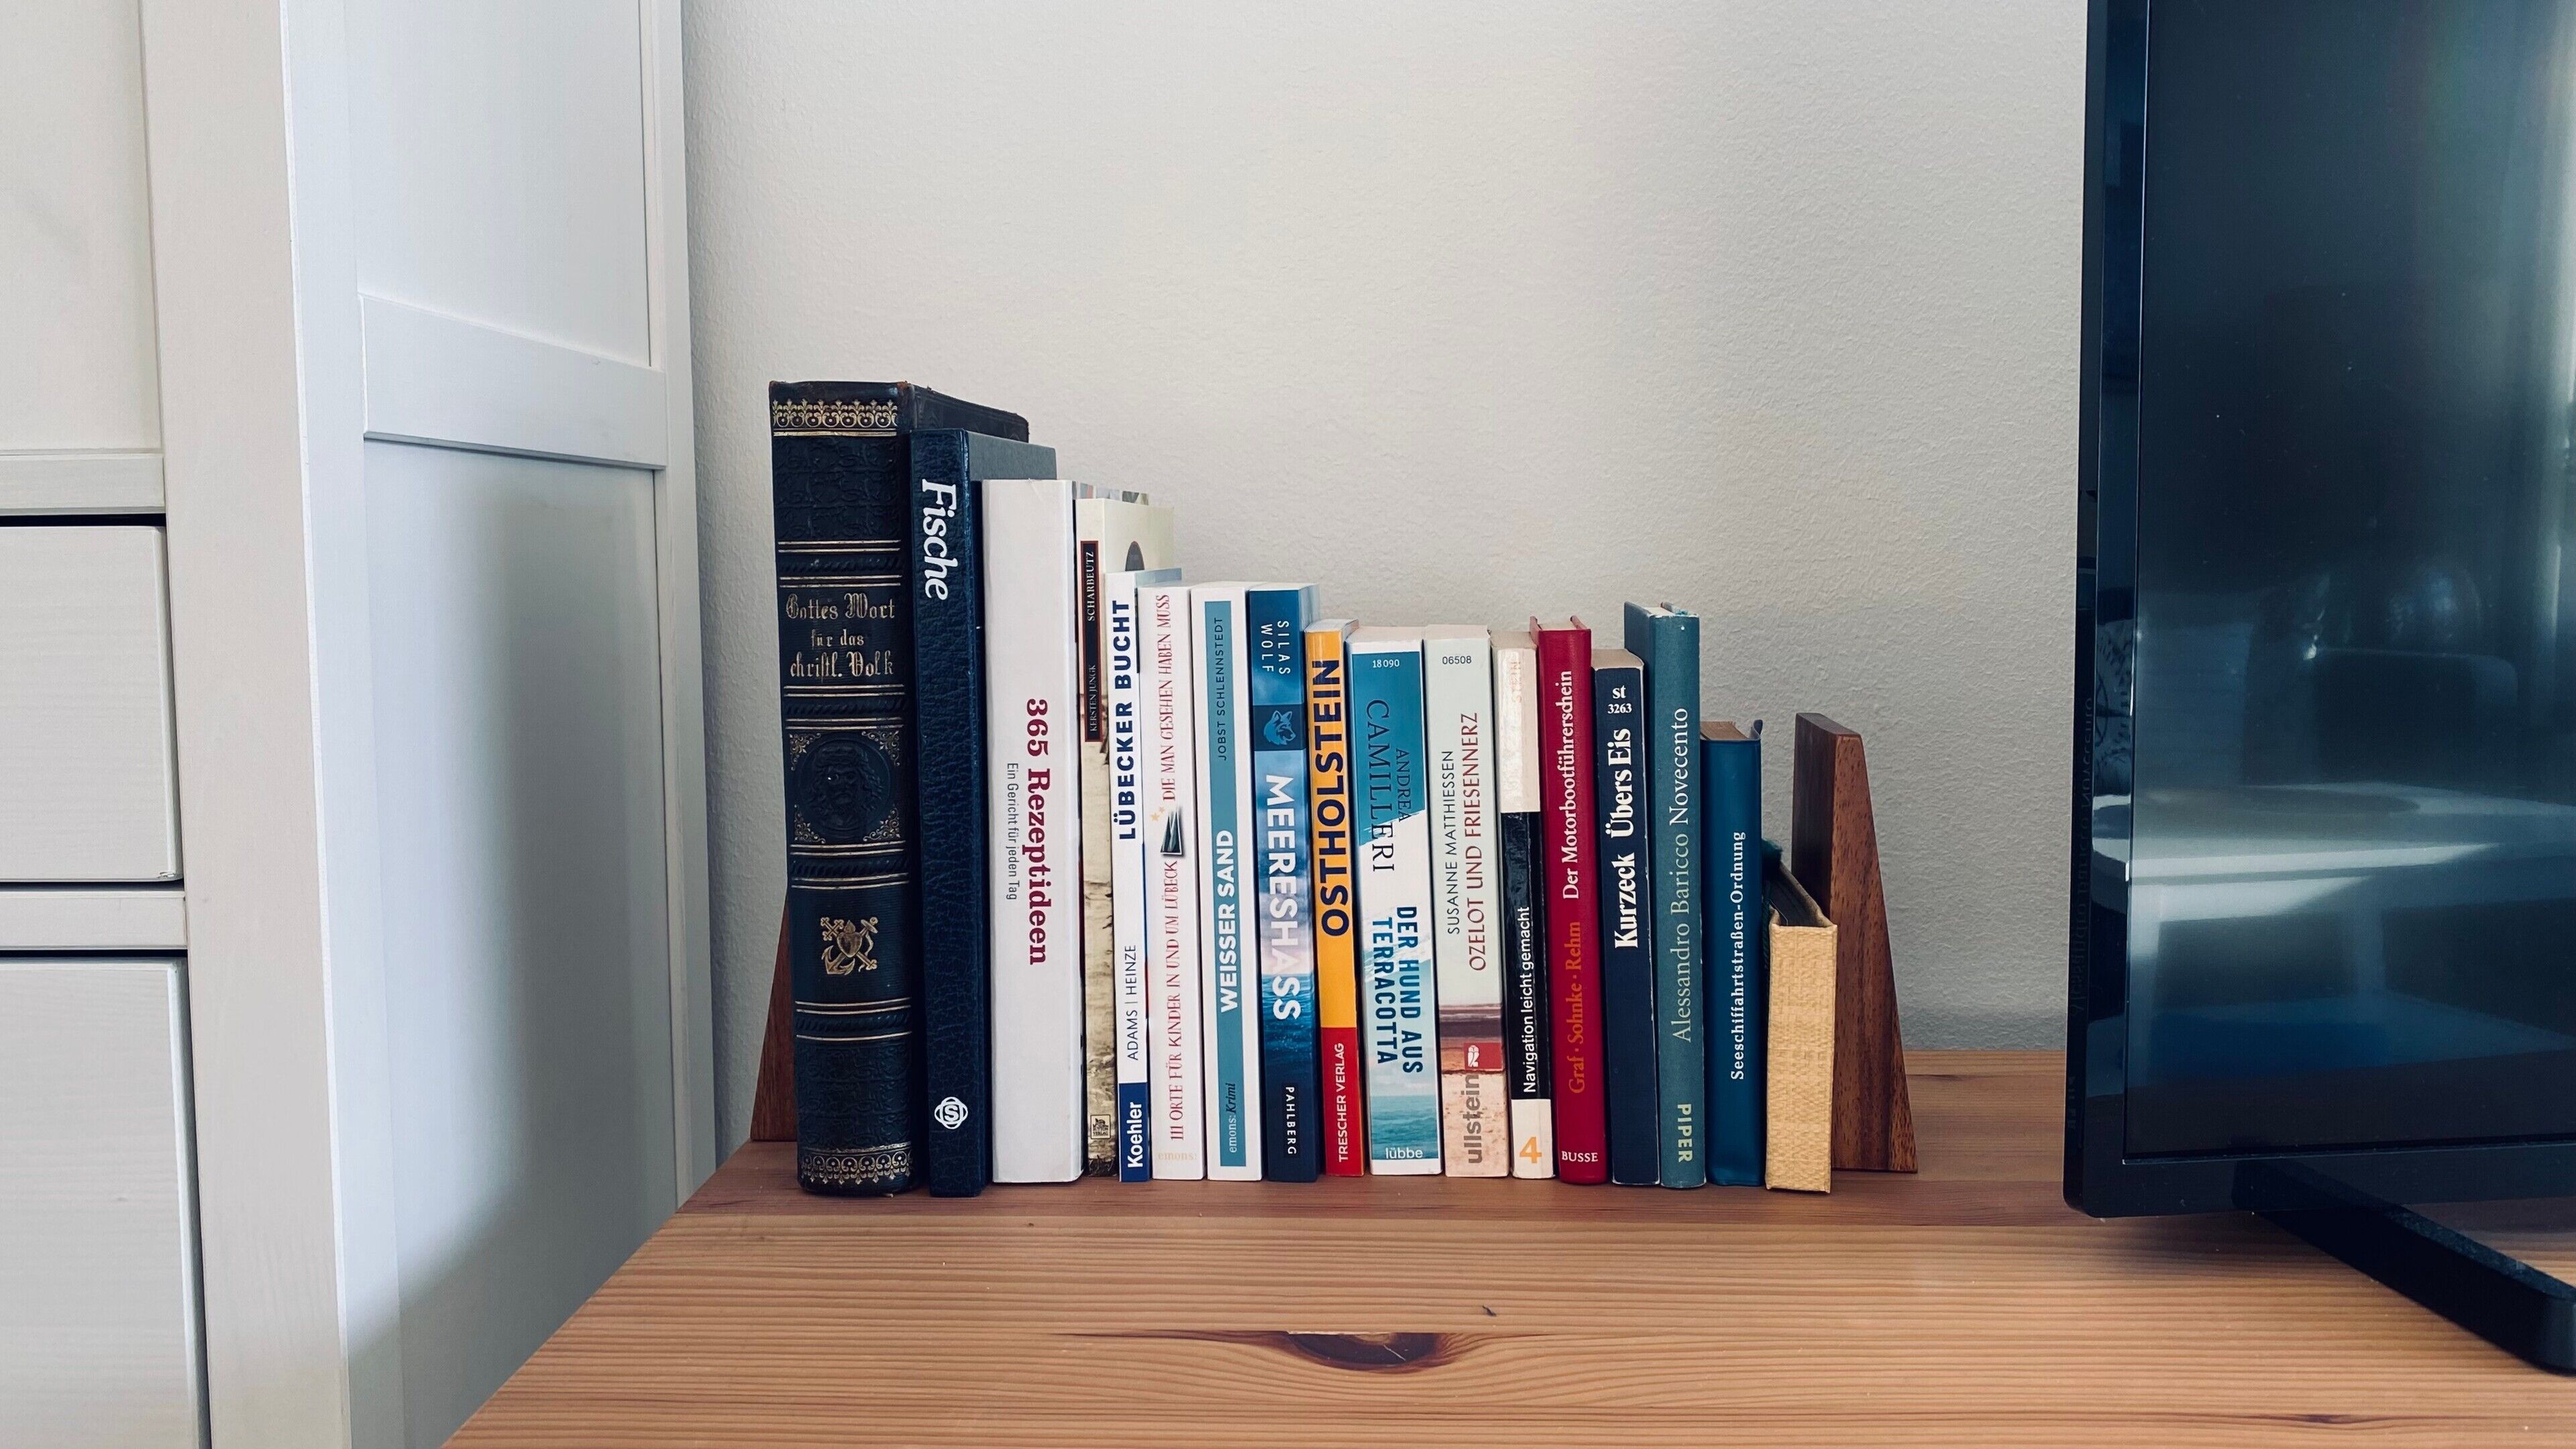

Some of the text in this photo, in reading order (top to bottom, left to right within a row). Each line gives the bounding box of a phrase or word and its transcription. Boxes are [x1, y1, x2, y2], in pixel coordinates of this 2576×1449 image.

[922, 478, 959, 600] Fische
[844, 592, 895, 619] Wort
[1085, 551, 1095, 621] SCHARBEUTZ
[1156, 594, 1171, 628] MUSS
[840, 629, 865, 646] das
[846, 650, 894, 677] Volk
[1158, 634, 1173, 675] HABEN
[1260, 624, 1274, 672] WOLF
[1277, 620, 1291, 675] SILAS
[1442, 655, 1472, 665] 06508
[1087, 664, 1097, 732] KERSTEN JUNGK
[1112, 600, 1136, 840] LÜBECKER BUCHT
[1159, 680, 1174, 740] GESEHEN
[1214, 617, 1227, 761] JOBST SCHLENNSTEDT
[1607, 703, 1632, 714] 3263
[1612, 685, 1627, 699] st
[1161, 745, 1175, 773] MAN
[1162, 777, 1177, 802] DIE
[1366, 699, 1395, 872] CAMILLERI
[1395, 748, 1411, 822] ANDREA
[1555, 671, 1579, 899] Der Motorbootführerschein
[1311, 659, 1350, 936] OSTHOLSTEIN
[1006, 763, 1020, 900] Ein Gericht für jeden Tag
[1022, 698, 1052, 965] 365 Rezeptideen
[1441, 751, 1460, 934] SUSANNE MATTHIESSEN
[1460, 712, 1486, 971] OZELOT UND FRIESENNERZ
[1605, 729, 1638, 949] Kurzeck Übers Eis
[1161, 861, 1178, 910] LÜBECK
[1266, 775, 1301, 1020] MEERESHASS
[1669, 708, 1691, 1042] Alessandro Baricco Novecento
[1164, 915, 1179, 934] UM
[1165, 939, 1180, 968] UND
[1216, 830, 1238, 1013] WEISSER SAND
[1166, 973, 1180, 987] IN
[1396, 906, 1424, 1073] DER HUND AUS
[1730, 832, 1746, 1080] Seeschiffahrtstraßen-Ordnung
[1125, 945, 1138, 1061] ADAMS HEINZE
[1167, 994, 1182, 1046] KINDER
[1372, 916, 1398, 1064] TERRACOTTA
[1517, 907, 1538, 1093] Navigation leicht gemacht
[1564, 922, 1585, 1093] Graf Sohnke Rehm
[1165, 1053, 1183, 1080] FÜR
[1226, 1083, 1236, 1114] Krimi
[1126, 1102, 1143, 1168] Koehler
[1169, 1085, 1183, 1121] ORTE
[1285, 1086, 1297, 1155] PAHLBERG
[1334, 1042, 1348, 1163] TRESCHER VERLAG
[1460, 1073, 1483, 1164] ullstein
[1677, 1103, 1693, 1163] PIPER
[1385, 1147, 1424, 1159] lübbe
[1519, 1136, 1542, 1164] 4
[1561, 1150, 1599, 1163] BUSSE
